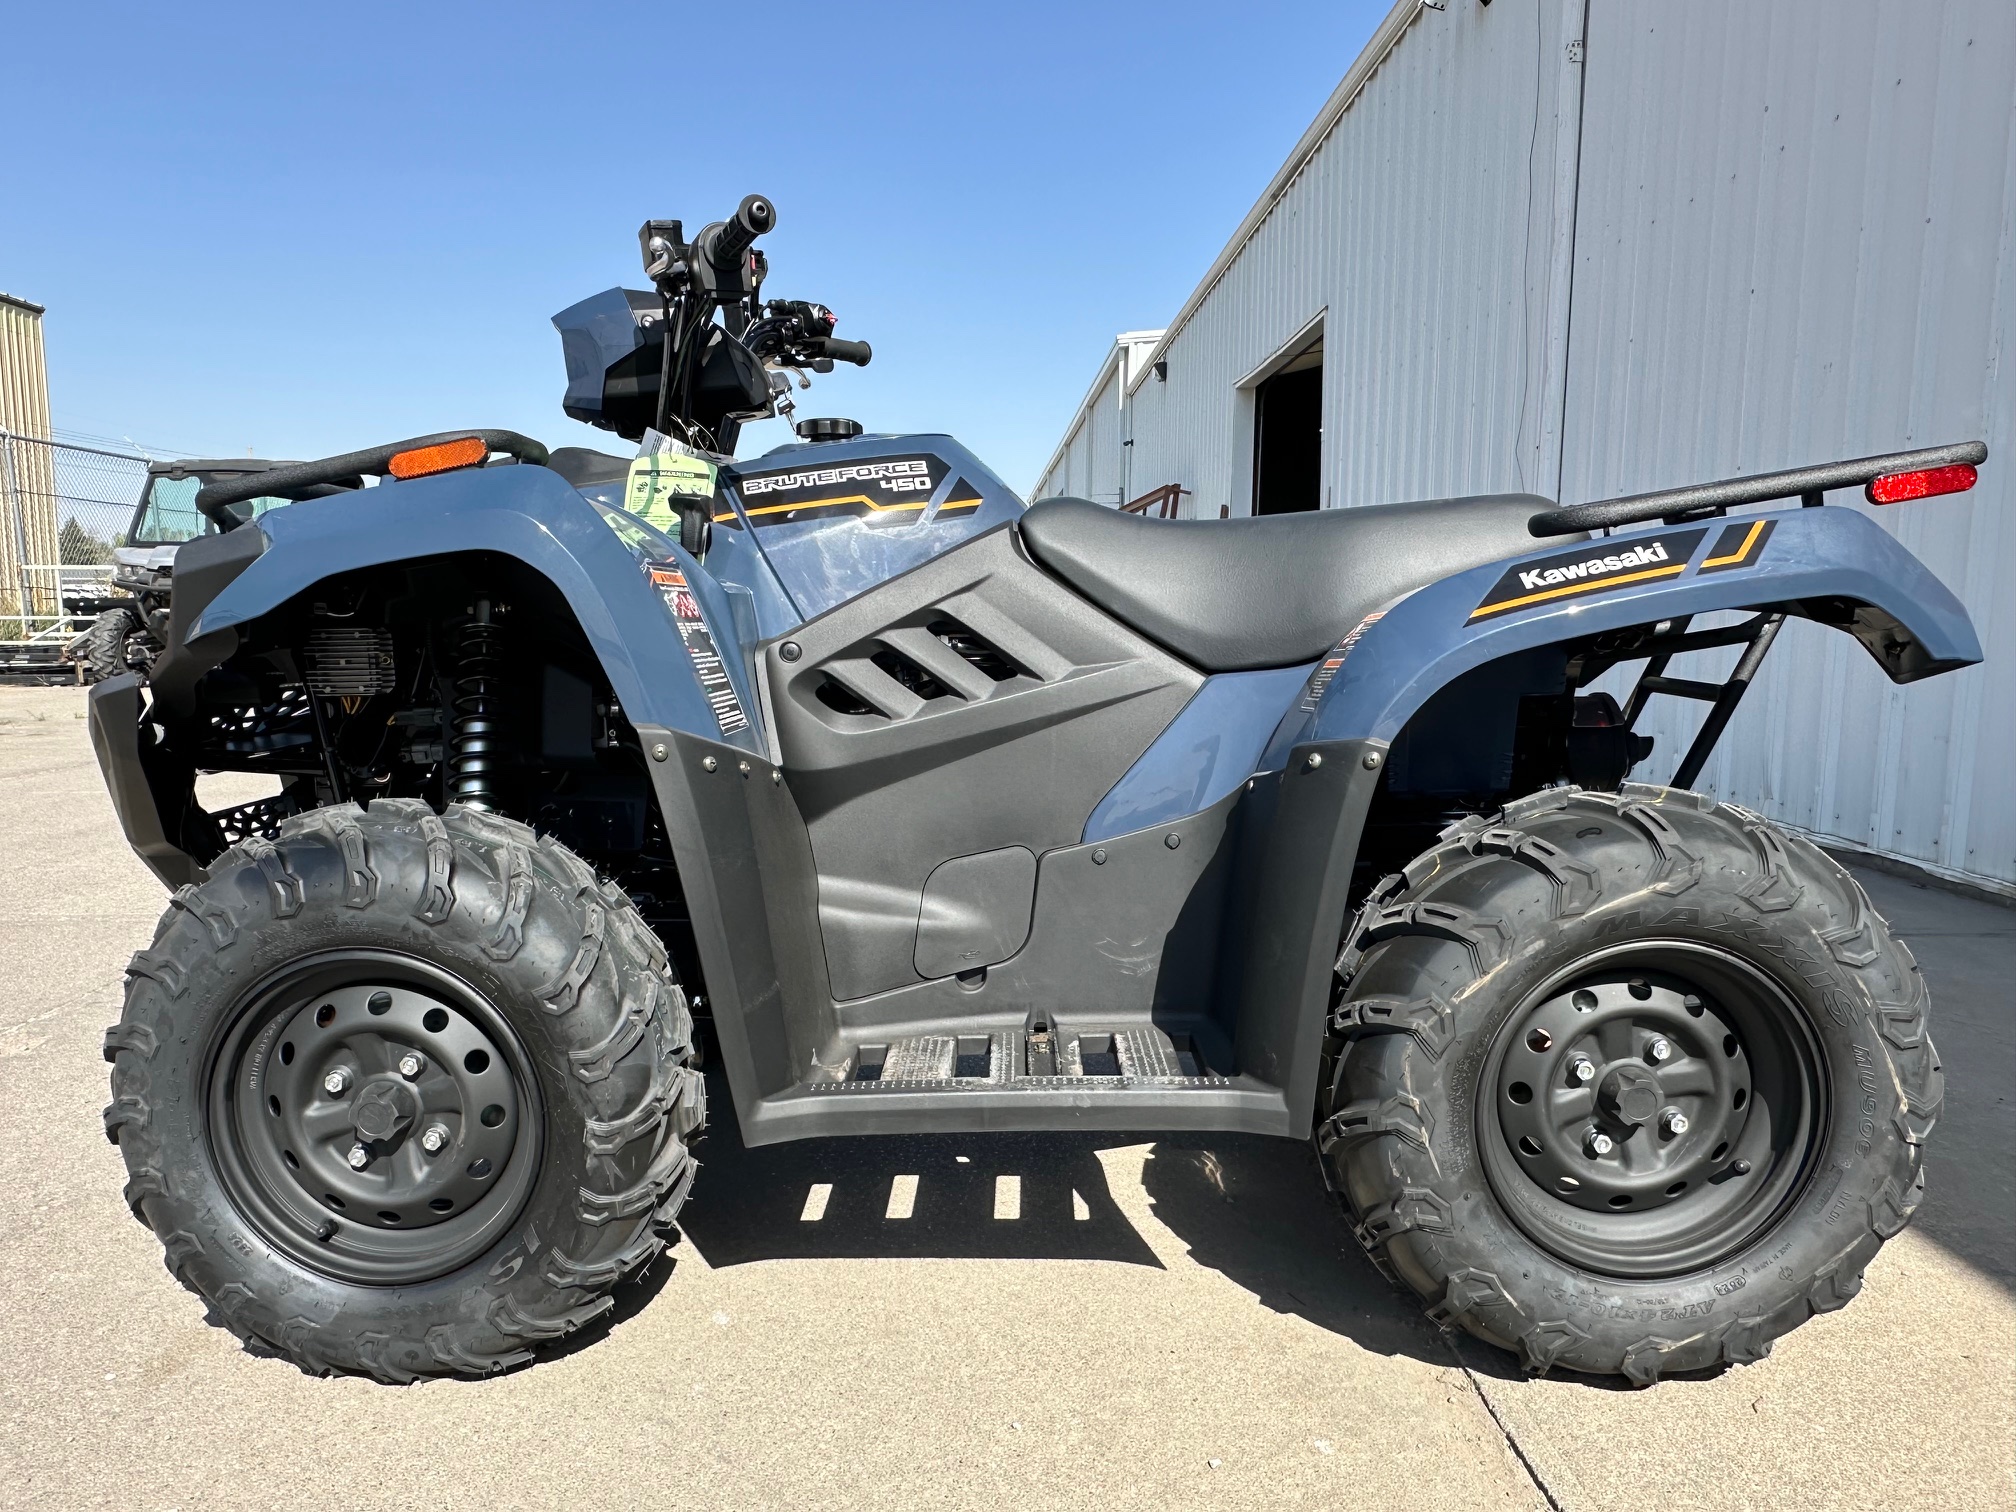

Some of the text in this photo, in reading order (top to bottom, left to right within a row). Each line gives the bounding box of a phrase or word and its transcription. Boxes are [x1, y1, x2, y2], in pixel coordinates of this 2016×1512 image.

[880, 477, 932, 492] 450
[1518, 542, 1669, 590] Kawasaki
[1589, 906, 1860, 1028] MAXXIS
[1826, 1189, 1850, 1228] NYLON
